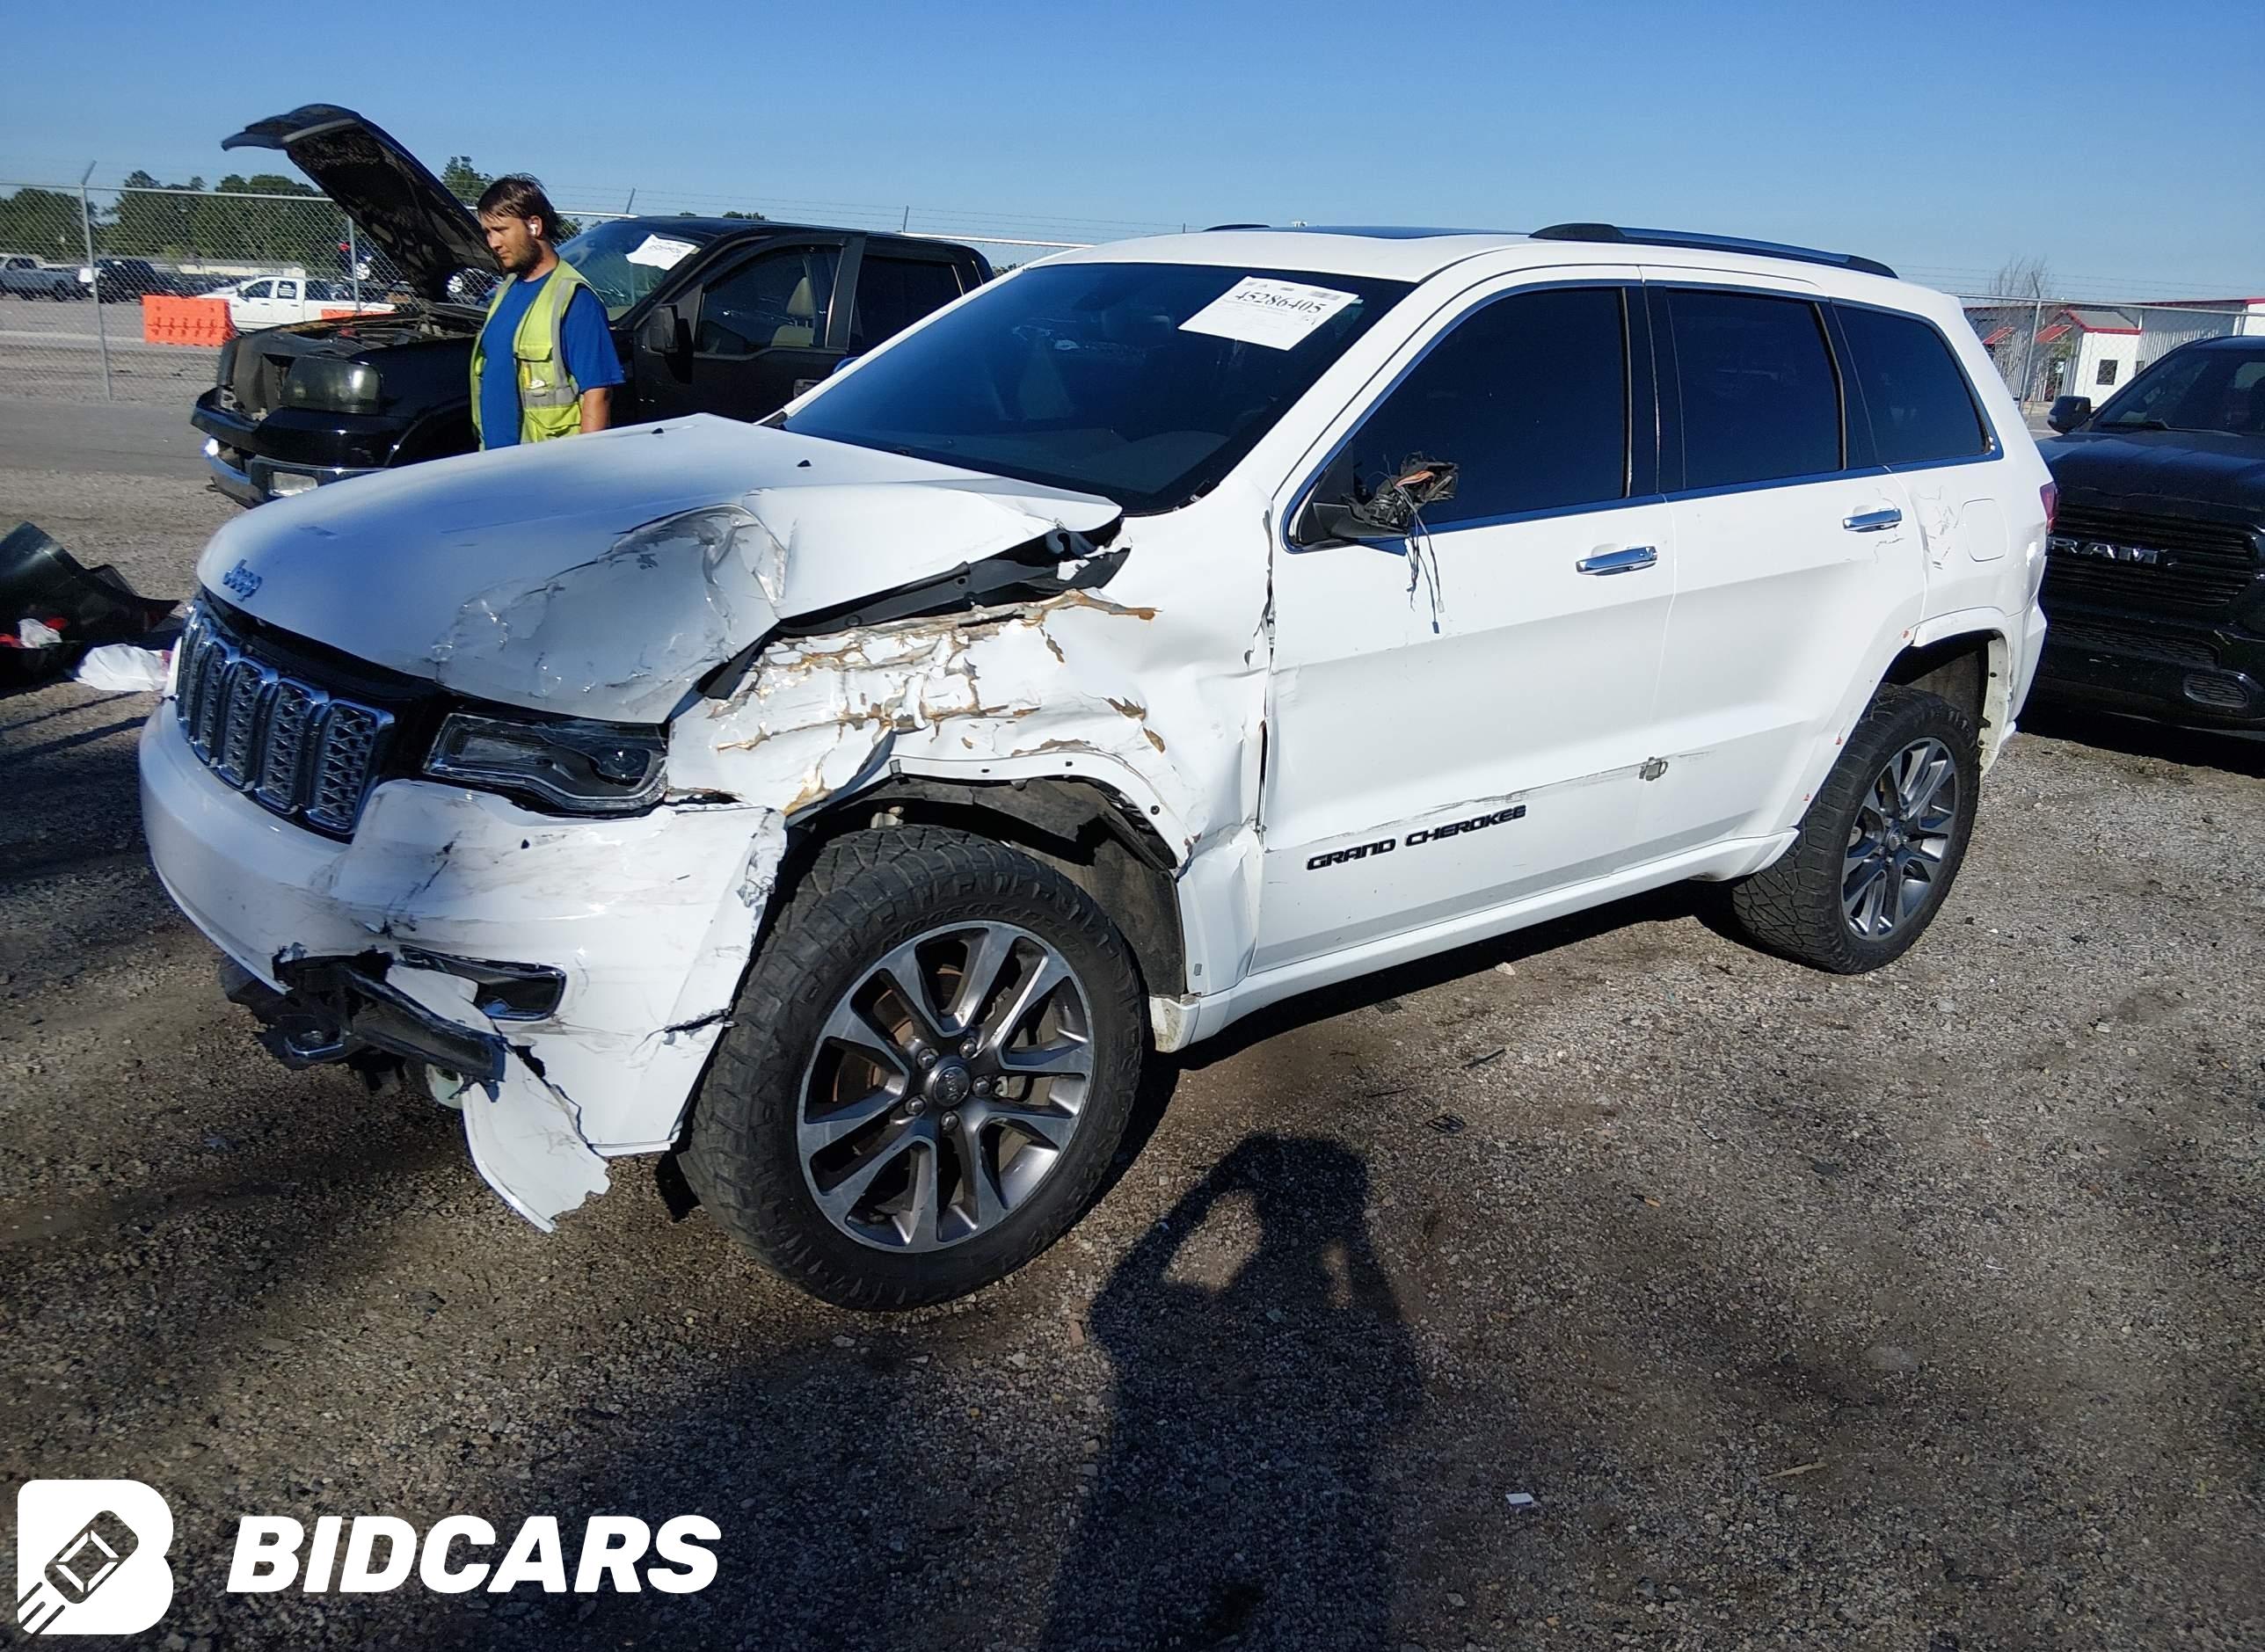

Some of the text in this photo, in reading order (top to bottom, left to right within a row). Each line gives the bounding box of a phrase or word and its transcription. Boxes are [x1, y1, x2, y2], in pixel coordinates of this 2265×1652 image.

[1235, 290, 1326, 314] 45286405
[2050, 536, 2159, 564] RAM
[222, 558, 262, 602] Jeep
[1307, 804, 1526, 870] GRAND CHEROKEE
